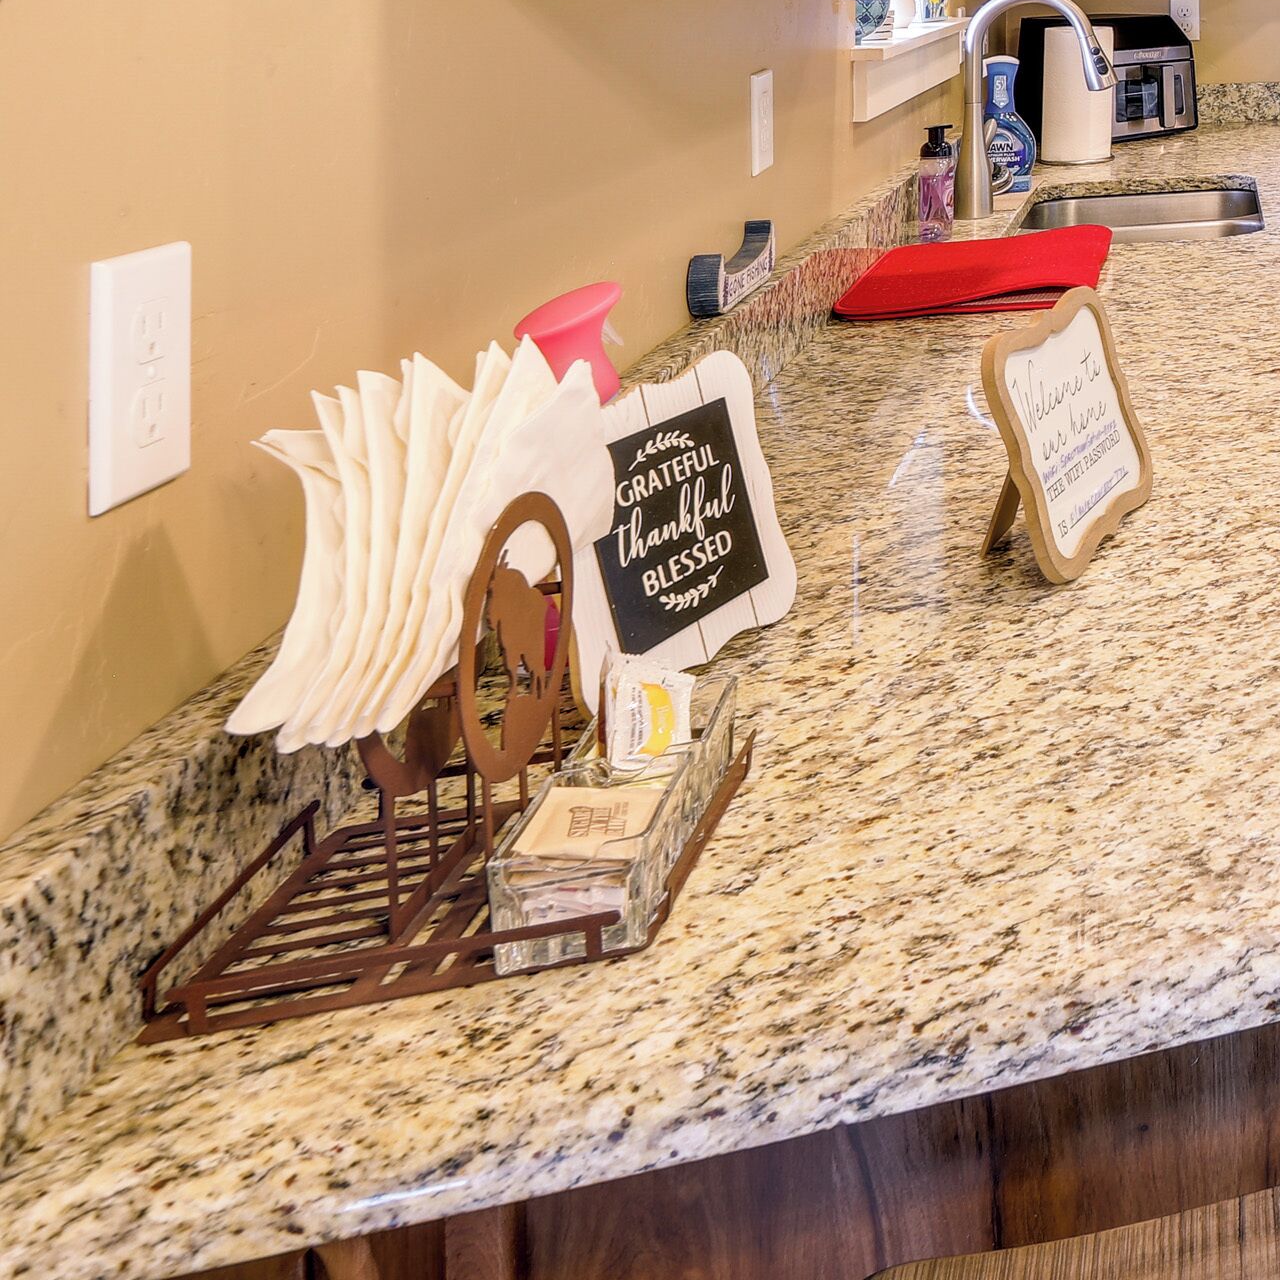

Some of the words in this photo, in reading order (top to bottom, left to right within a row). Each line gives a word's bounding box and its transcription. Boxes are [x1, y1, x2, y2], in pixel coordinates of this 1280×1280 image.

[990, 143, 1013, 151] AWN
[728, 274, 745, 297] GONE
[746, 256, 768, 283] FISHING
[1012, 360, 1082, 433] Welcome
[1080, 347, 1101, 382] to
[1042, 429, 1067, 461] our
[1068, 401, 1106, 436] home
[616, 443, 720, 508] GRATEFUL
[1046, 478, 1066, 502] THE
[1063, 461, 1085, 486] WIFI
[1083, 429, 1121, 470] PASSWORD
[612, 463, 736, 568] thankful
[1057, 520, 1069, 538] IS
[641, 530, 733, 597] BLESSED
